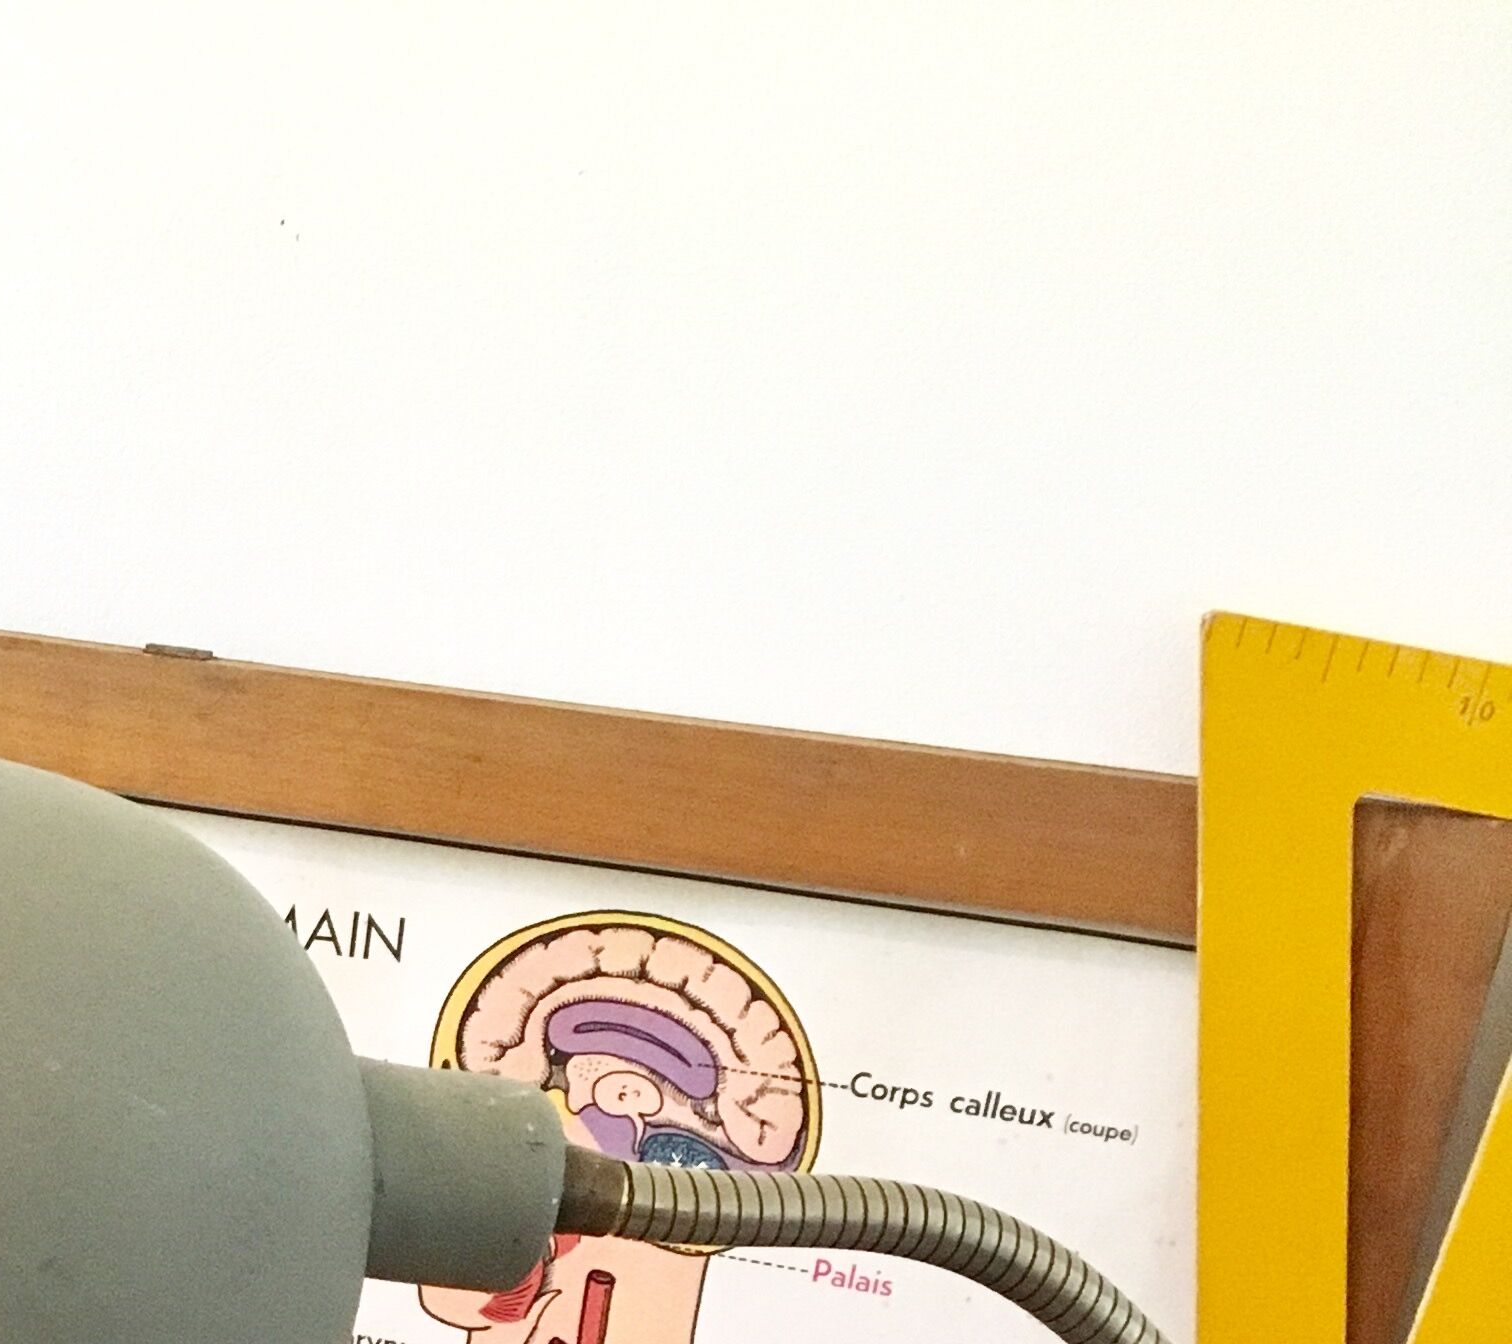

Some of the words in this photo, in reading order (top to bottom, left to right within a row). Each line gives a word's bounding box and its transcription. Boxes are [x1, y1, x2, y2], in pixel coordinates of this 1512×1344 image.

[1459, 695, 1495, 722] 10
[850, 1071, 934, 1114] Corps
[950, 1091, 1056, 1130] calleux
[1062, 1113, 1141, 1147] (coupe)
[812, 1260, 894, 1298] Palais
